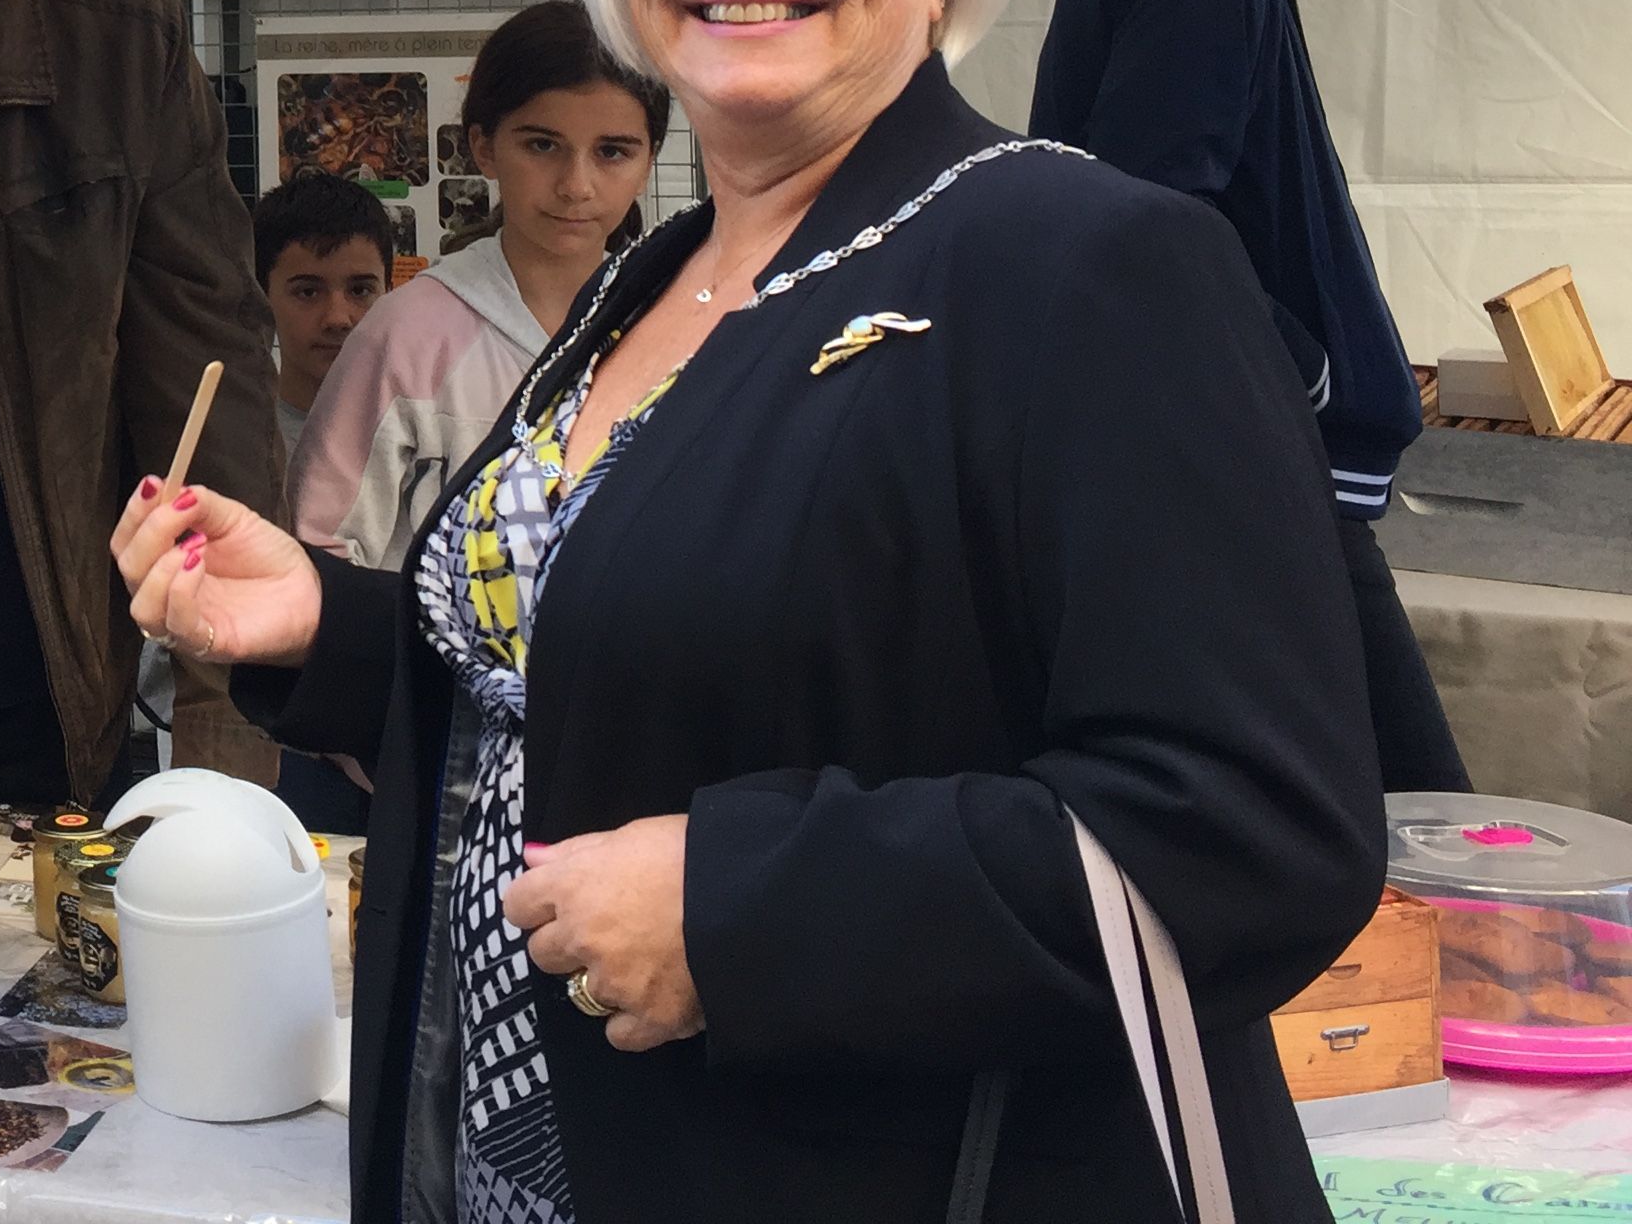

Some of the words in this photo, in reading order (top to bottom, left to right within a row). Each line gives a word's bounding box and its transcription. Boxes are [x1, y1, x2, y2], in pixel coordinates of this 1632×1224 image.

[274, 39, 293, 54] La
[348, 38, 389, 53] mère
[411, 35, 452, 56] plein
